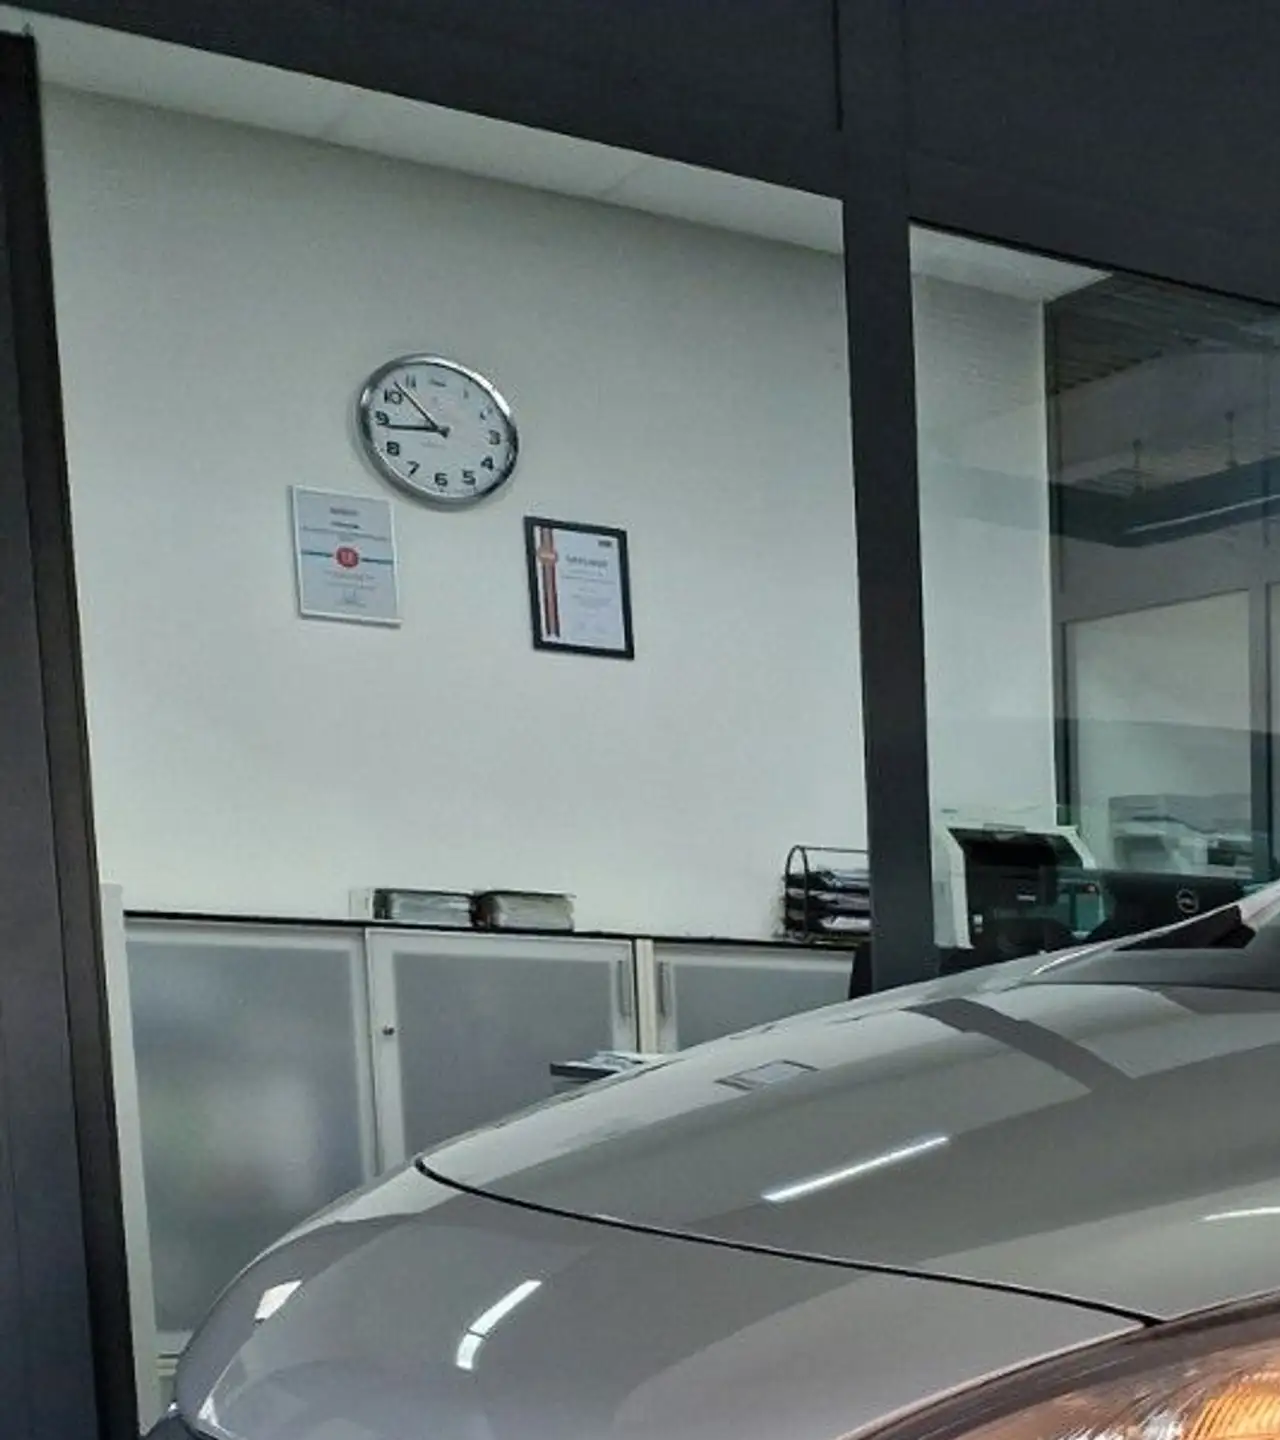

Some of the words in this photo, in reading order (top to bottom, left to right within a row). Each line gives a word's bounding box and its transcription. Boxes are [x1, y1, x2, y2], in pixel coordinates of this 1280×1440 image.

[384, 389, 404, 405] 10
[375, 410, 390, 426] 9
[488, 430, 501, 446] 3
[386, 440, 400, 457] 8
[407, 460, 420, 476] 7
[480, 456, 494, 471] 4
[433, 472, 448, 487] 6
[462, 469, 477, 486] 5
